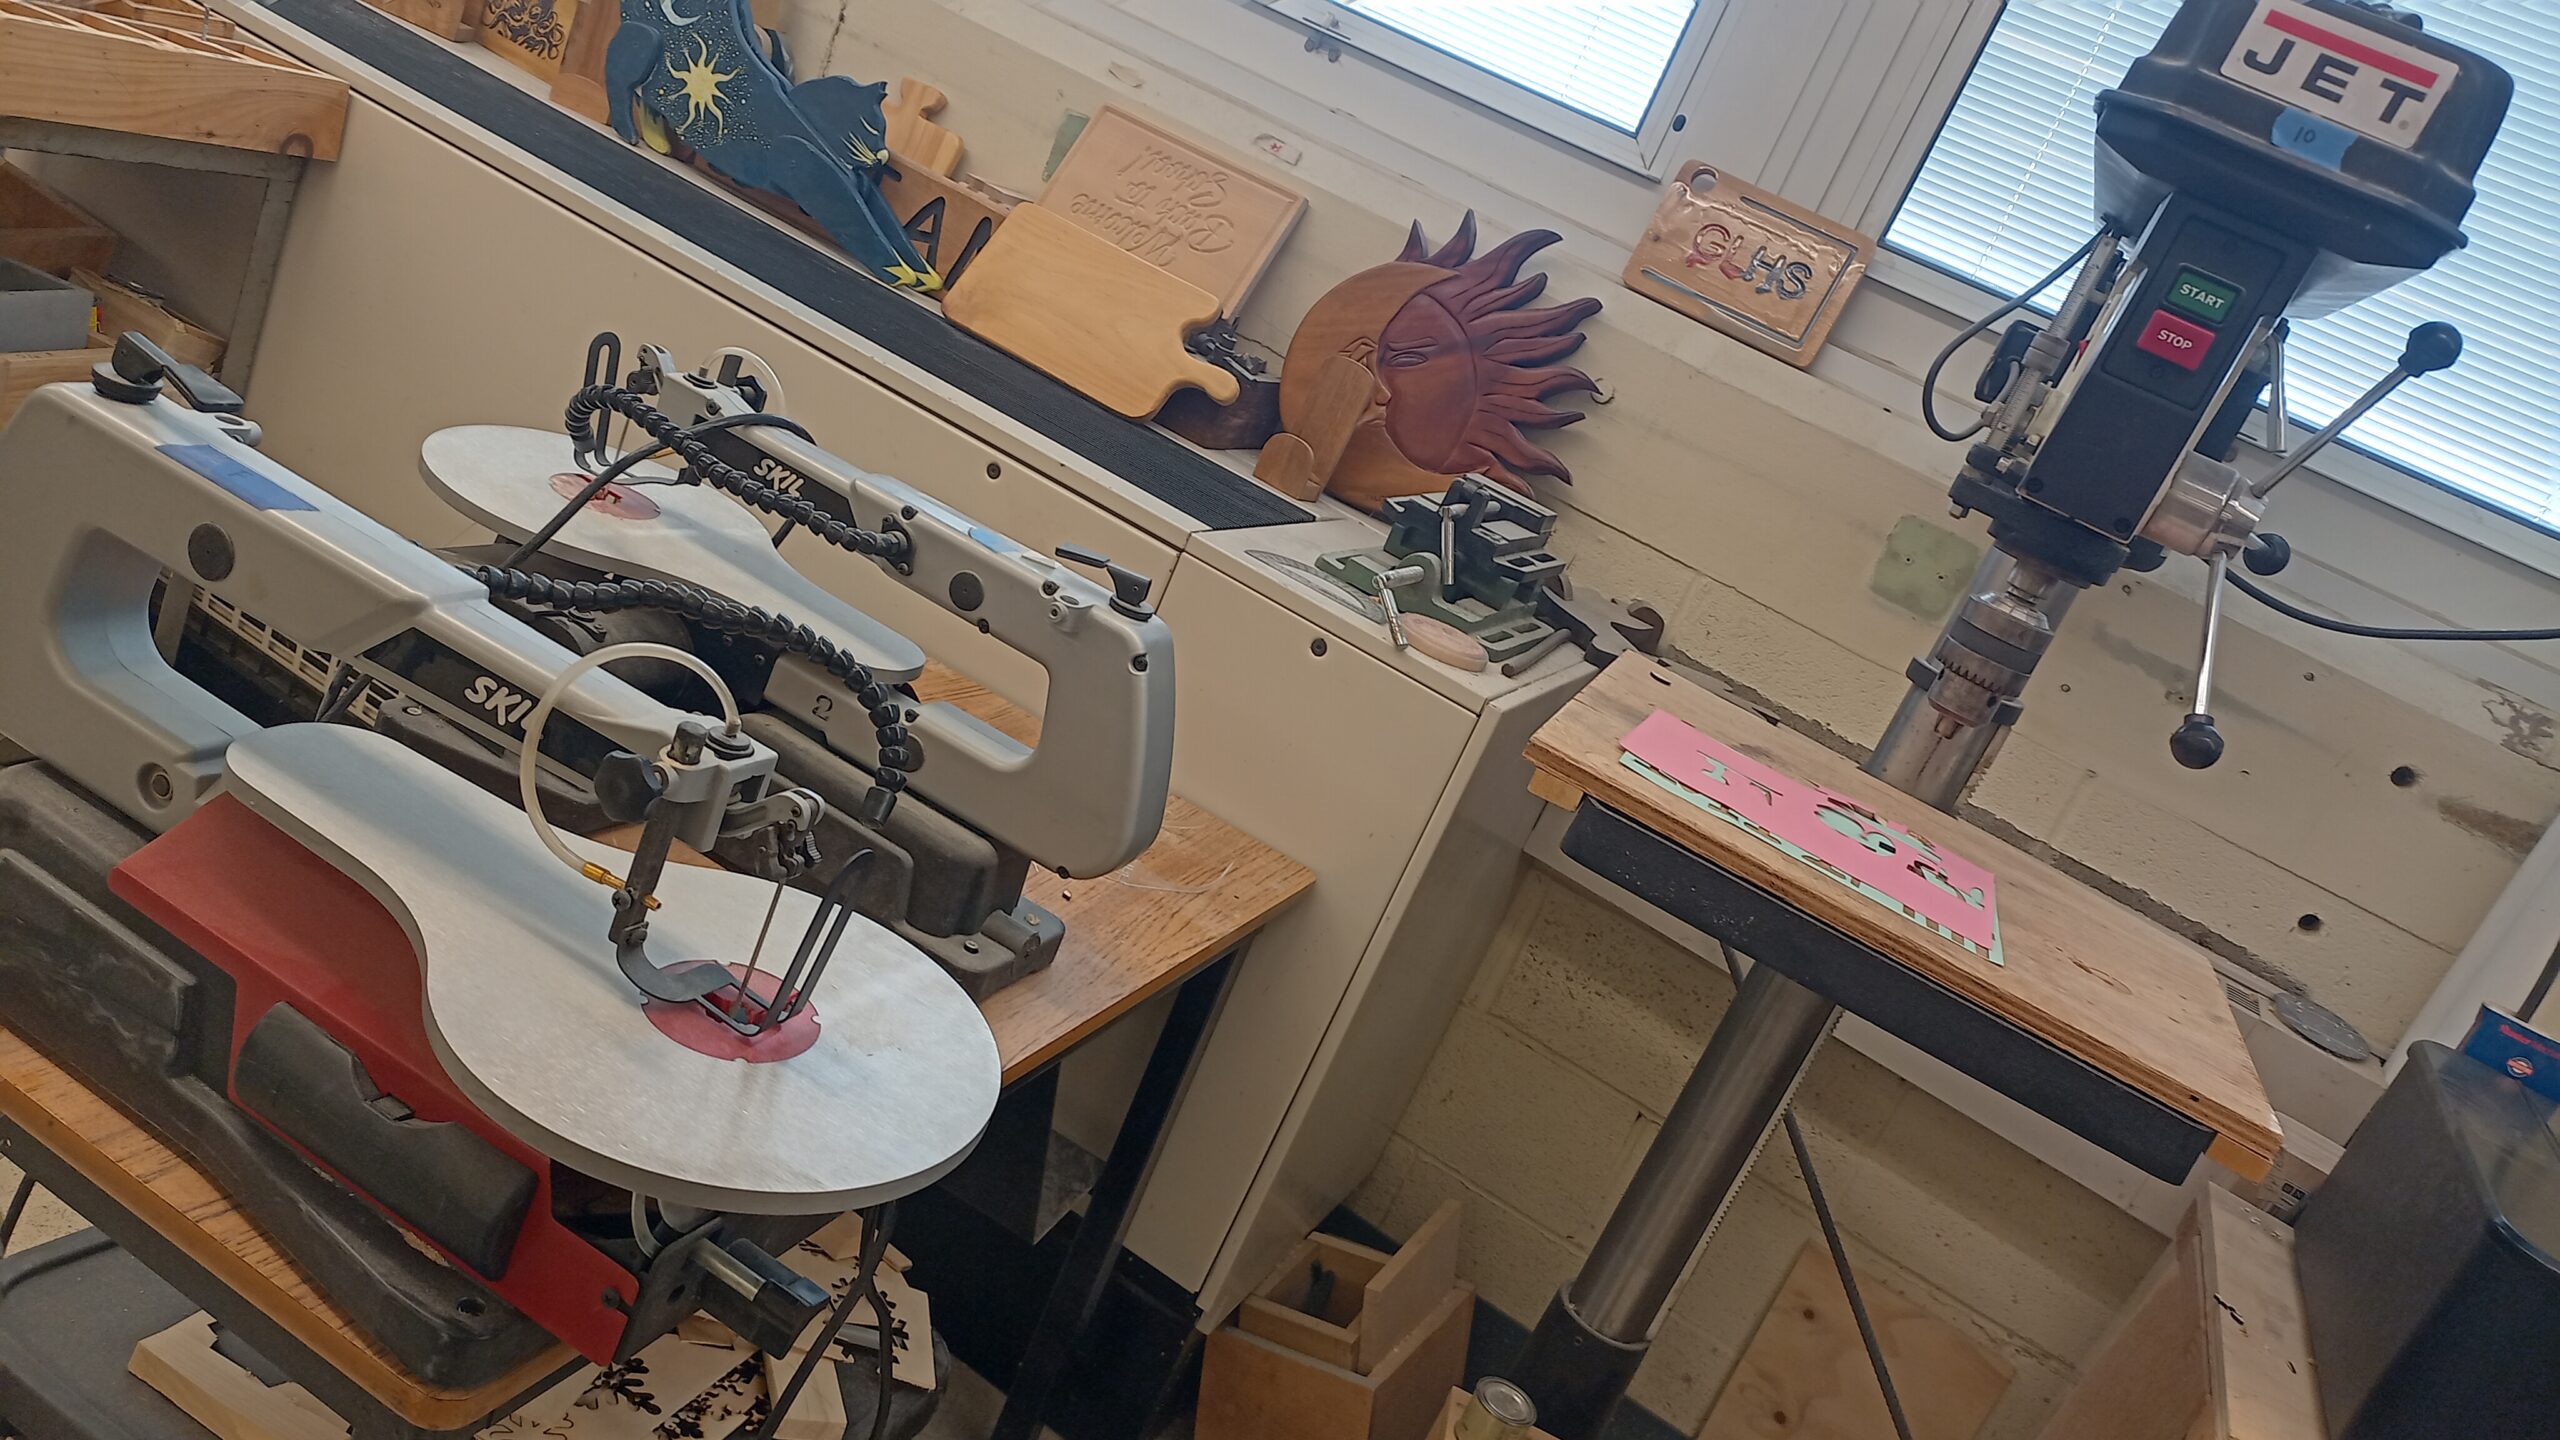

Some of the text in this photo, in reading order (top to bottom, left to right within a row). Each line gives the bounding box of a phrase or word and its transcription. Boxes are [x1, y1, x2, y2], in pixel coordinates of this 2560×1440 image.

[2243, 38, 2427, 124] JET
[2293, 127, 2316, 143] 10
[1686, 223, 1813, 300] GLHS
[2180, 283, 2224, 309] START
[2157, 329, 2193, 350] STOP
[753, 458, 804, 501] SKIL
[464, 676, 543, 741] SKI
[812, 694, 833, 722] 2
